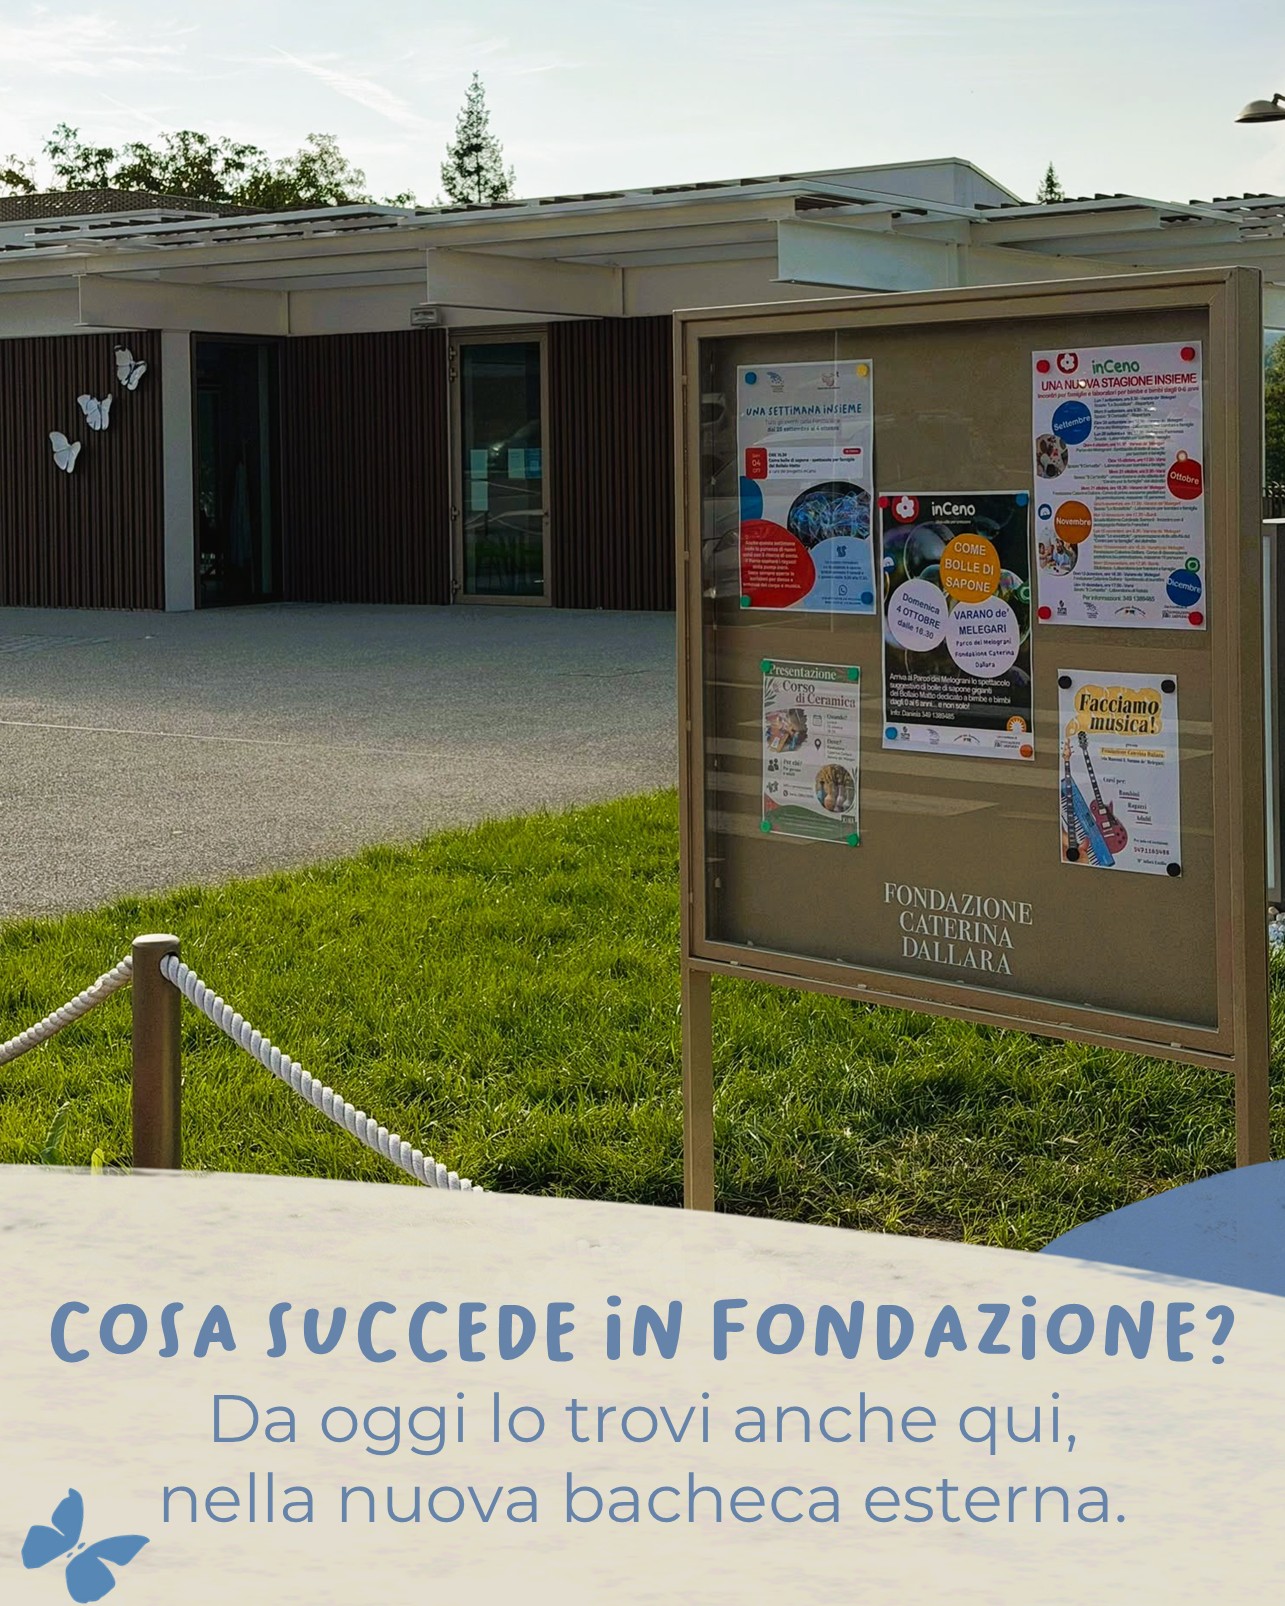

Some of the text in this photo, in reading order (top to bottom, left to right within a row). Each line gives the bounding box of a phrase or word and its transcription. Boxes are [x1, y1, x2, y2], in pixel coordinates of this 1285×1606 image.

[1092, 360, 1140, 374] inCeno
[1042, 372, 1197, 391] UNA NUOVA STAGIONE INSIEME
[746, 406, 766, 416] UNA
[1054, 416, 1090, 431] Settembre
[1170, 471, 1199, 485] Ottobre
[932, 502, 975, 516] inCeno
[1056, 517, 1091, 526] Novembre
[954, 542, 986, 556] COME
[945, 558, 994, 575] BOLLE DI
[945, 577, 990, 593] SAPONE
[1166, 578, 1200, 593] Dicembre
[902, 593, 940, 615] Domenica
[903, 607, 941, 629] OTTOBRE
[954, 608, 1009, 620] VARANO de'
[898, 620, 914, 631] dalle
[958, 624, 1007, 635] MELEGARI
[983, 638, 1011, 647] Melograni
[770, 664, 837, 680] Presentazione
[890, 673, 907, 681] Arriva
[941, 676, 970, 685] Melograni
[782, 680, 815, 693] Corso
[890, 682, 920, 690] suggestivo
[972, 687, 992, 695] giganti
[796, 694, 855, 708] di Ceramica
[1080, 694, 1159, 715] Facciamo
[1090, 715, 1155, 734] musica!
[884, 882, 1033, 925] FONDAZIONE
[900, 911, 1014, 949] CATERINA
[902, 936, 1012, 975] DALLARA
